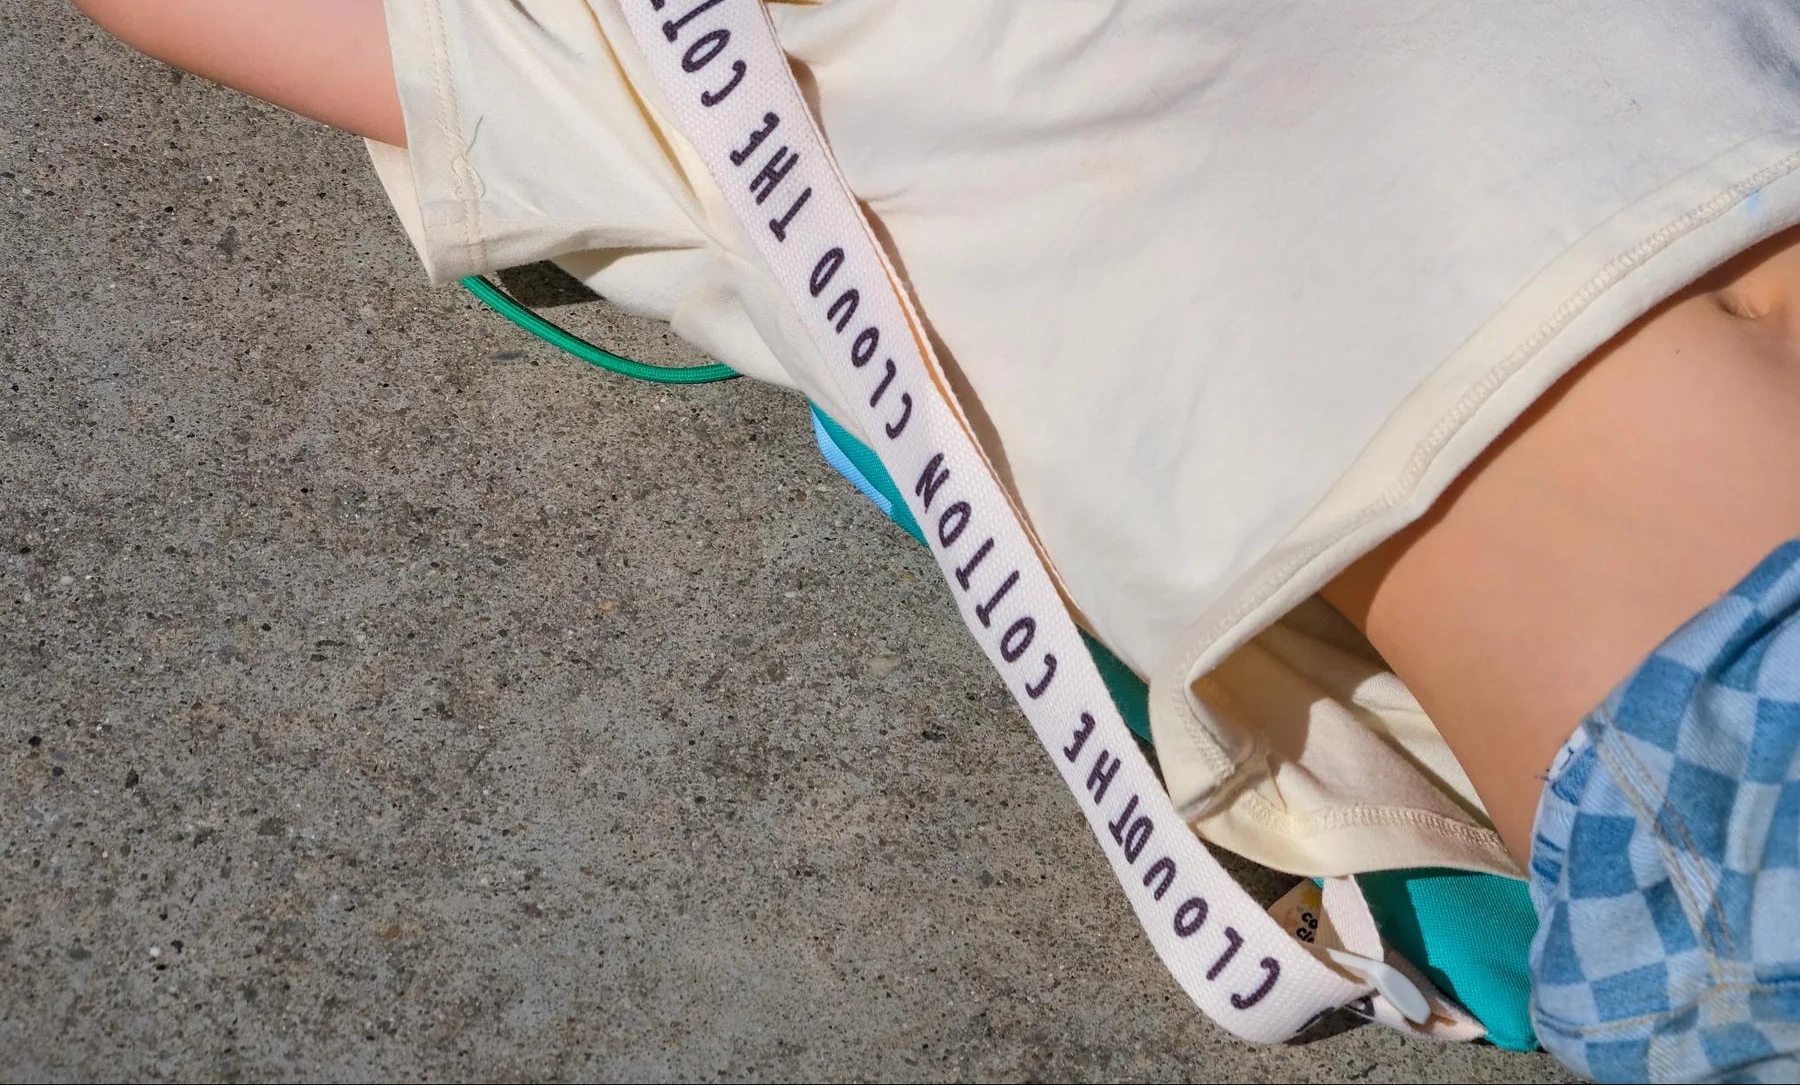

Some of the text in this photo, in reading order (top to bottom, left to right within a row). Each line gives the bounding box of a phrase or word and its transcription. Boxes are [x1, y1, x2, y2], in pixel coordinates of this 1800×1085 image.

[730, 112, 811, 242] THE
[810, 248, 912, 439] CLOUD
[916, 454, 1057, 699] COTTON
